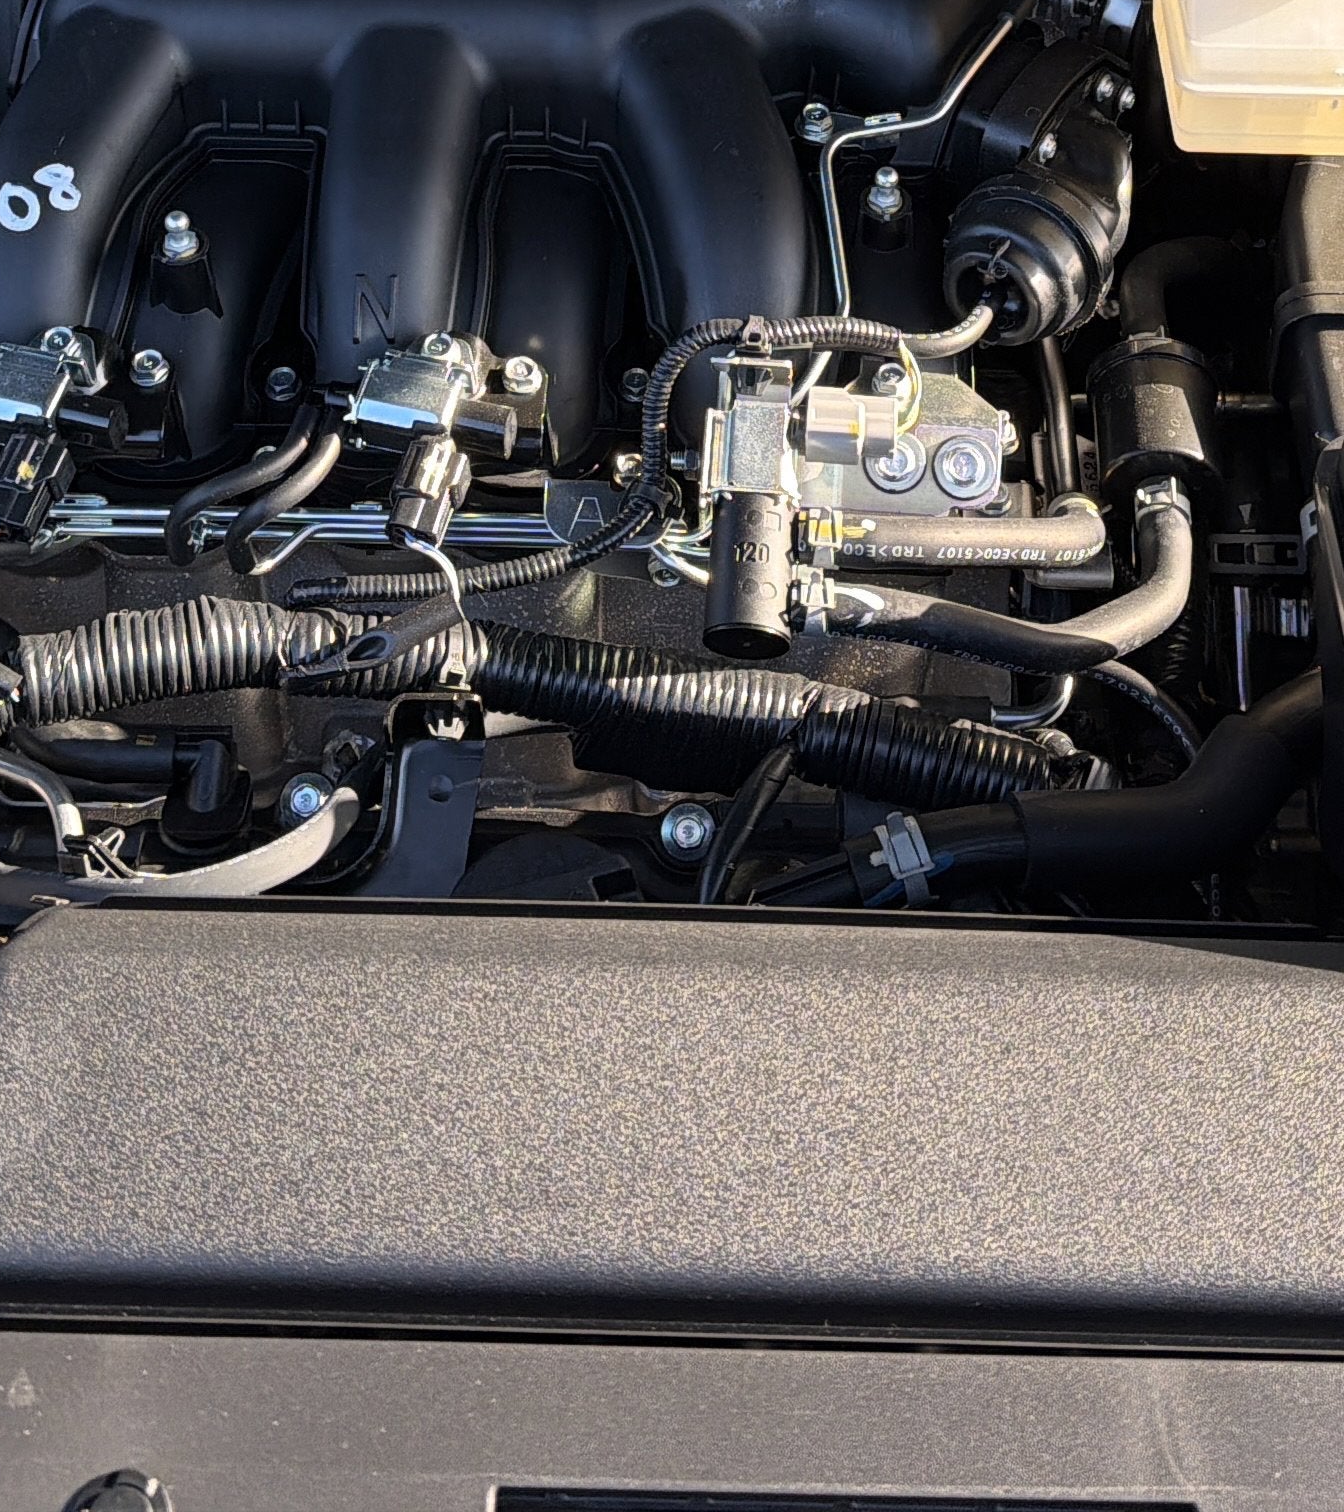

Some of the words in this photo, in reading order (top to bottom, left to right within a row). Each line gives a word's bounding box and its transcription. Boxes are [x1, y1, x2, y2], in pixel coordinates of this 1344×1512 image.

[351, 273, 399, 345] N
[567, 497, 605, 538] A
[733, 541, 770, 563] 120
